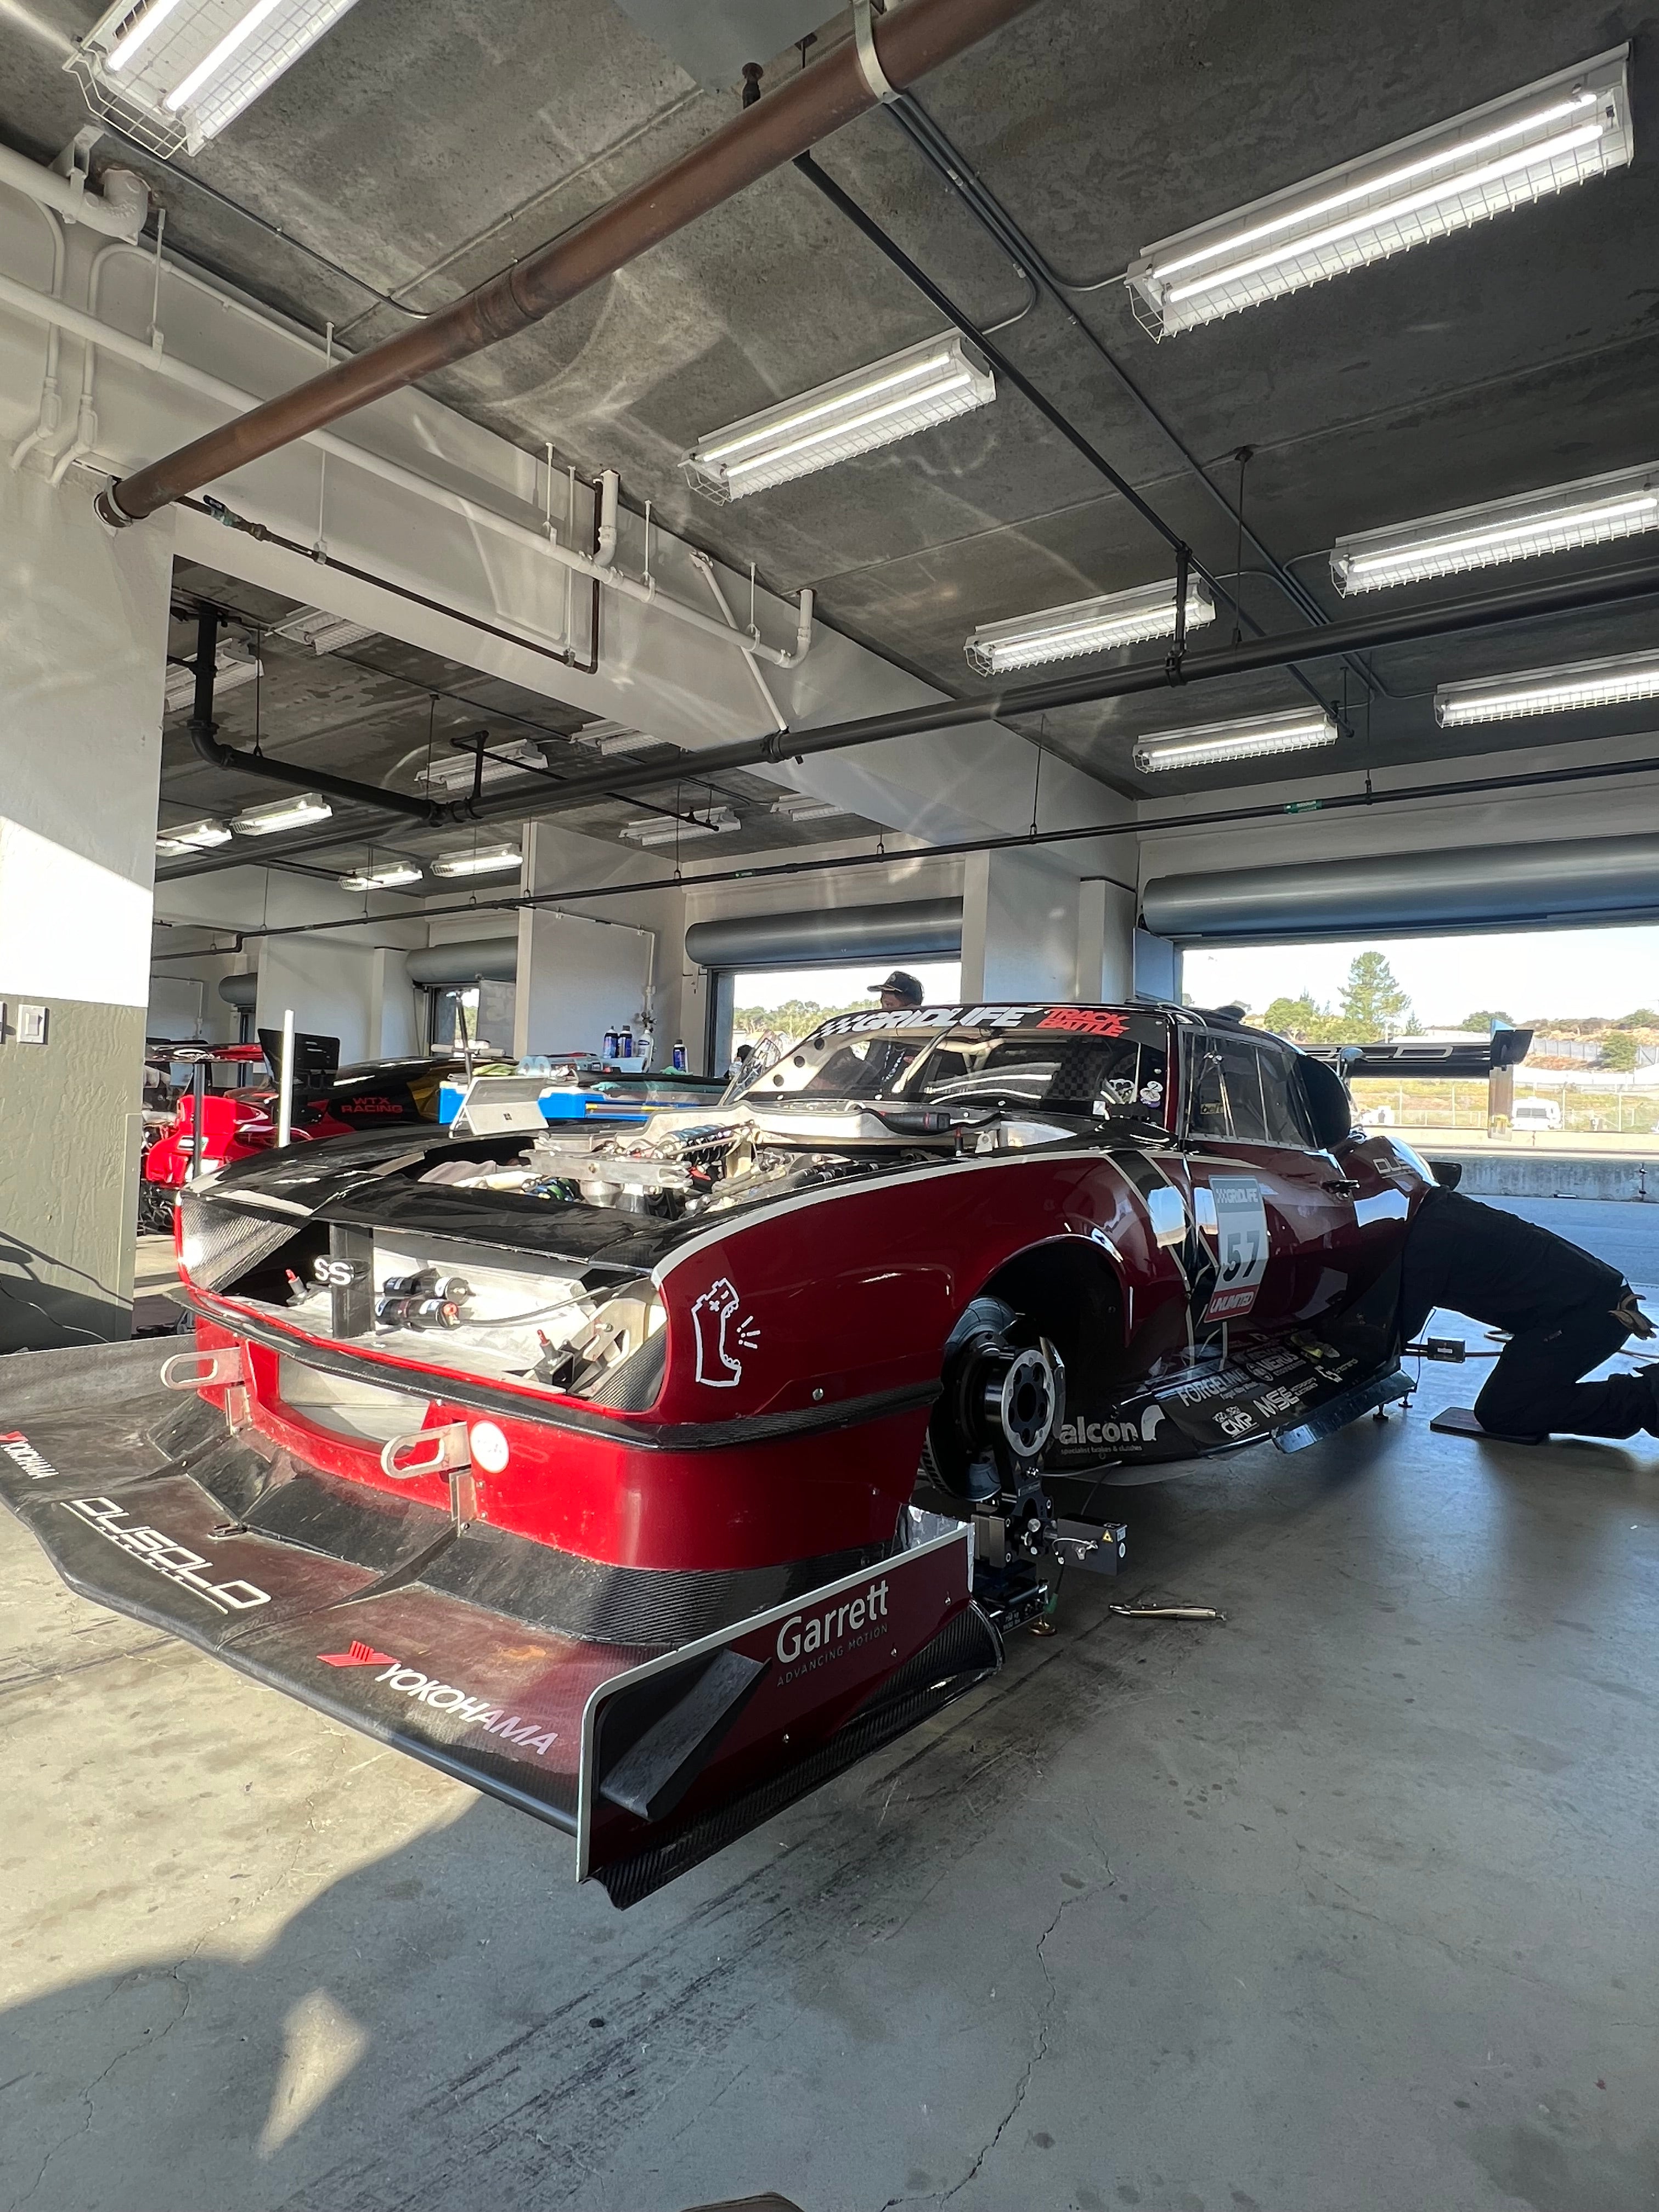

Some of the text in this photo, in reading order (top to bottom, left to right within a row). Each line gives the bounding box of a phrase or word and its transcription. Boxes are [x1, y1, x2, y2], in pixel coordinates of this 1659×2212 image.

[851, 1007, 1044, 1032] GRIDLIFE
[1036, 1018, 1131, 1037] BATTLE
[1046, 1008, 1131, 1025] TRACK
[341, 1105, 403, 1113] RACING
[1226, 1188, 1259, 1204] GRIDLIFE
[1223, 1230, 1260, 1282] 57
[1210, 1291, 1255, 1313] UNLIMITED
[1177, 1368, 1251, 1407] FORGELINE
[1252, 1386, 1300, 1418] MSE
[1059, 1416, 1139, 1445] alcon
[1, 1439, 59, 1480] YOKOHAMA
[777, 1579, 889, 1663] Garrett
[777, 1623, 888, 1687] ADVANCING MOTION
[374, 1663, 558, 1755] YOKOHAMA
